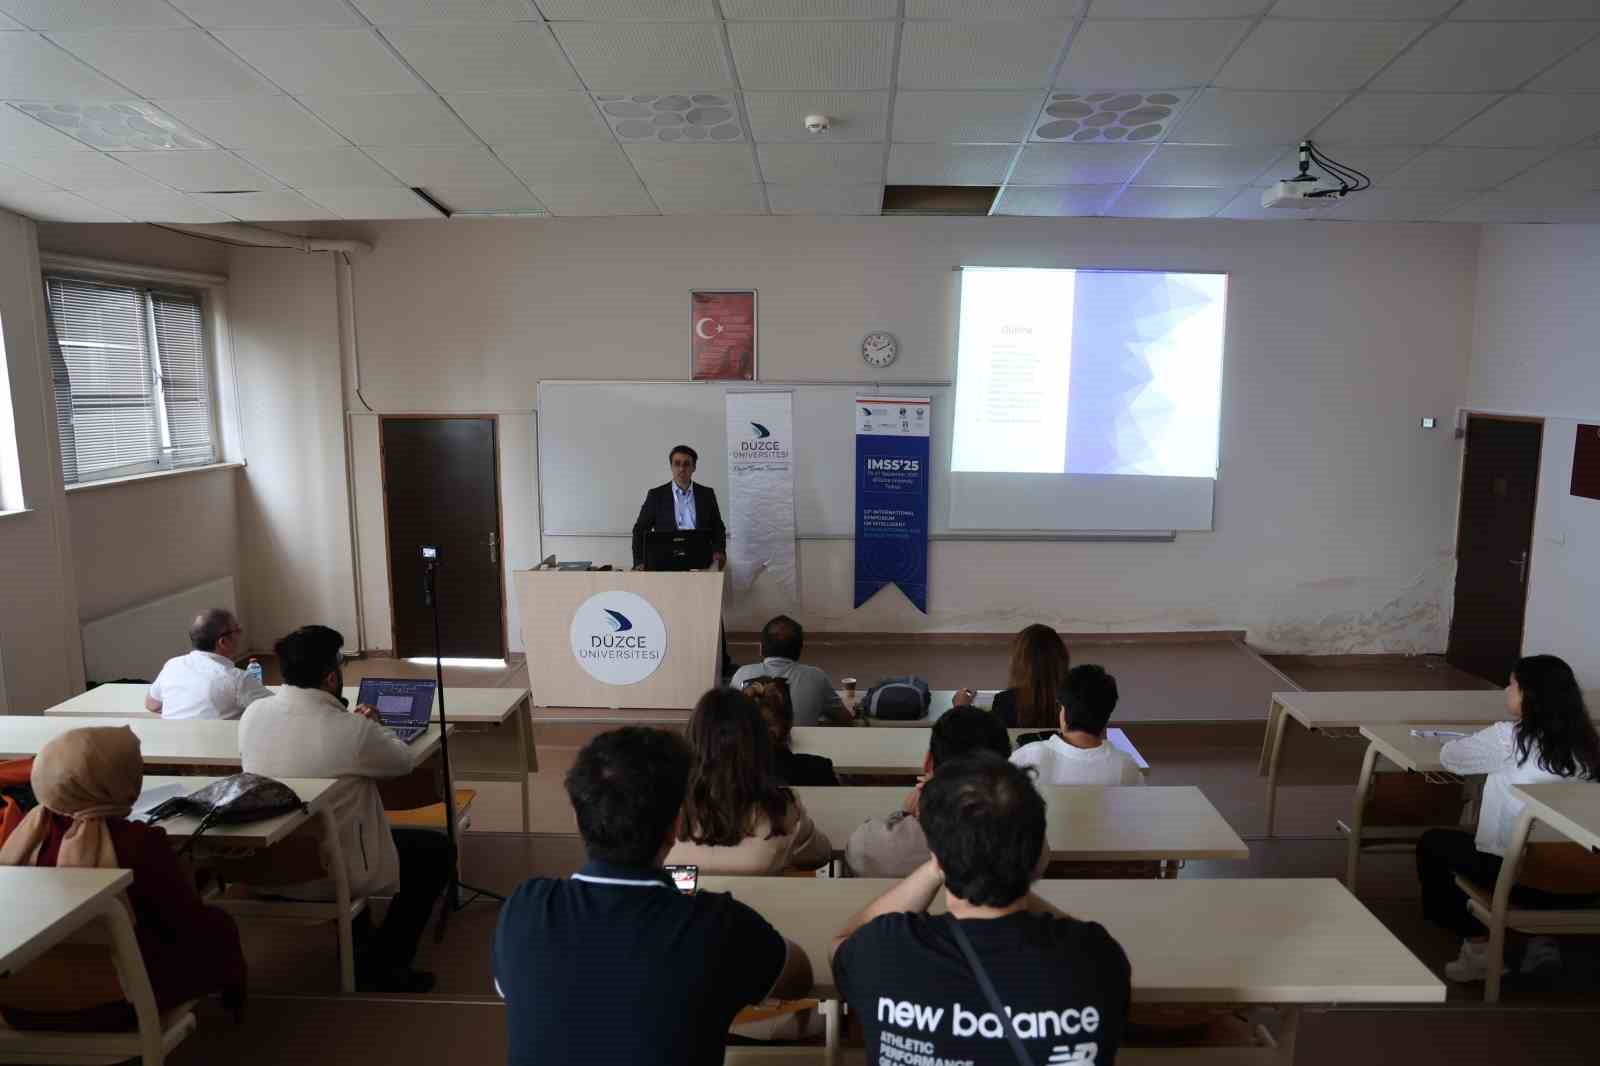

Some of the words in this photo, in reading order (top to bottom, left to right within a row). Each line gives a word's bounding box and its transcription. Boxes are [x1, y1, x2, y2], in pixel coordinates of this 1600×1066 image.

[867, 458, 920, 471] IMSS'25
[877, 997, 944, 1032] new
[952, 1003, 1100, 1038] baance
[880, 1031, 934, 1055] ATHLETIC
